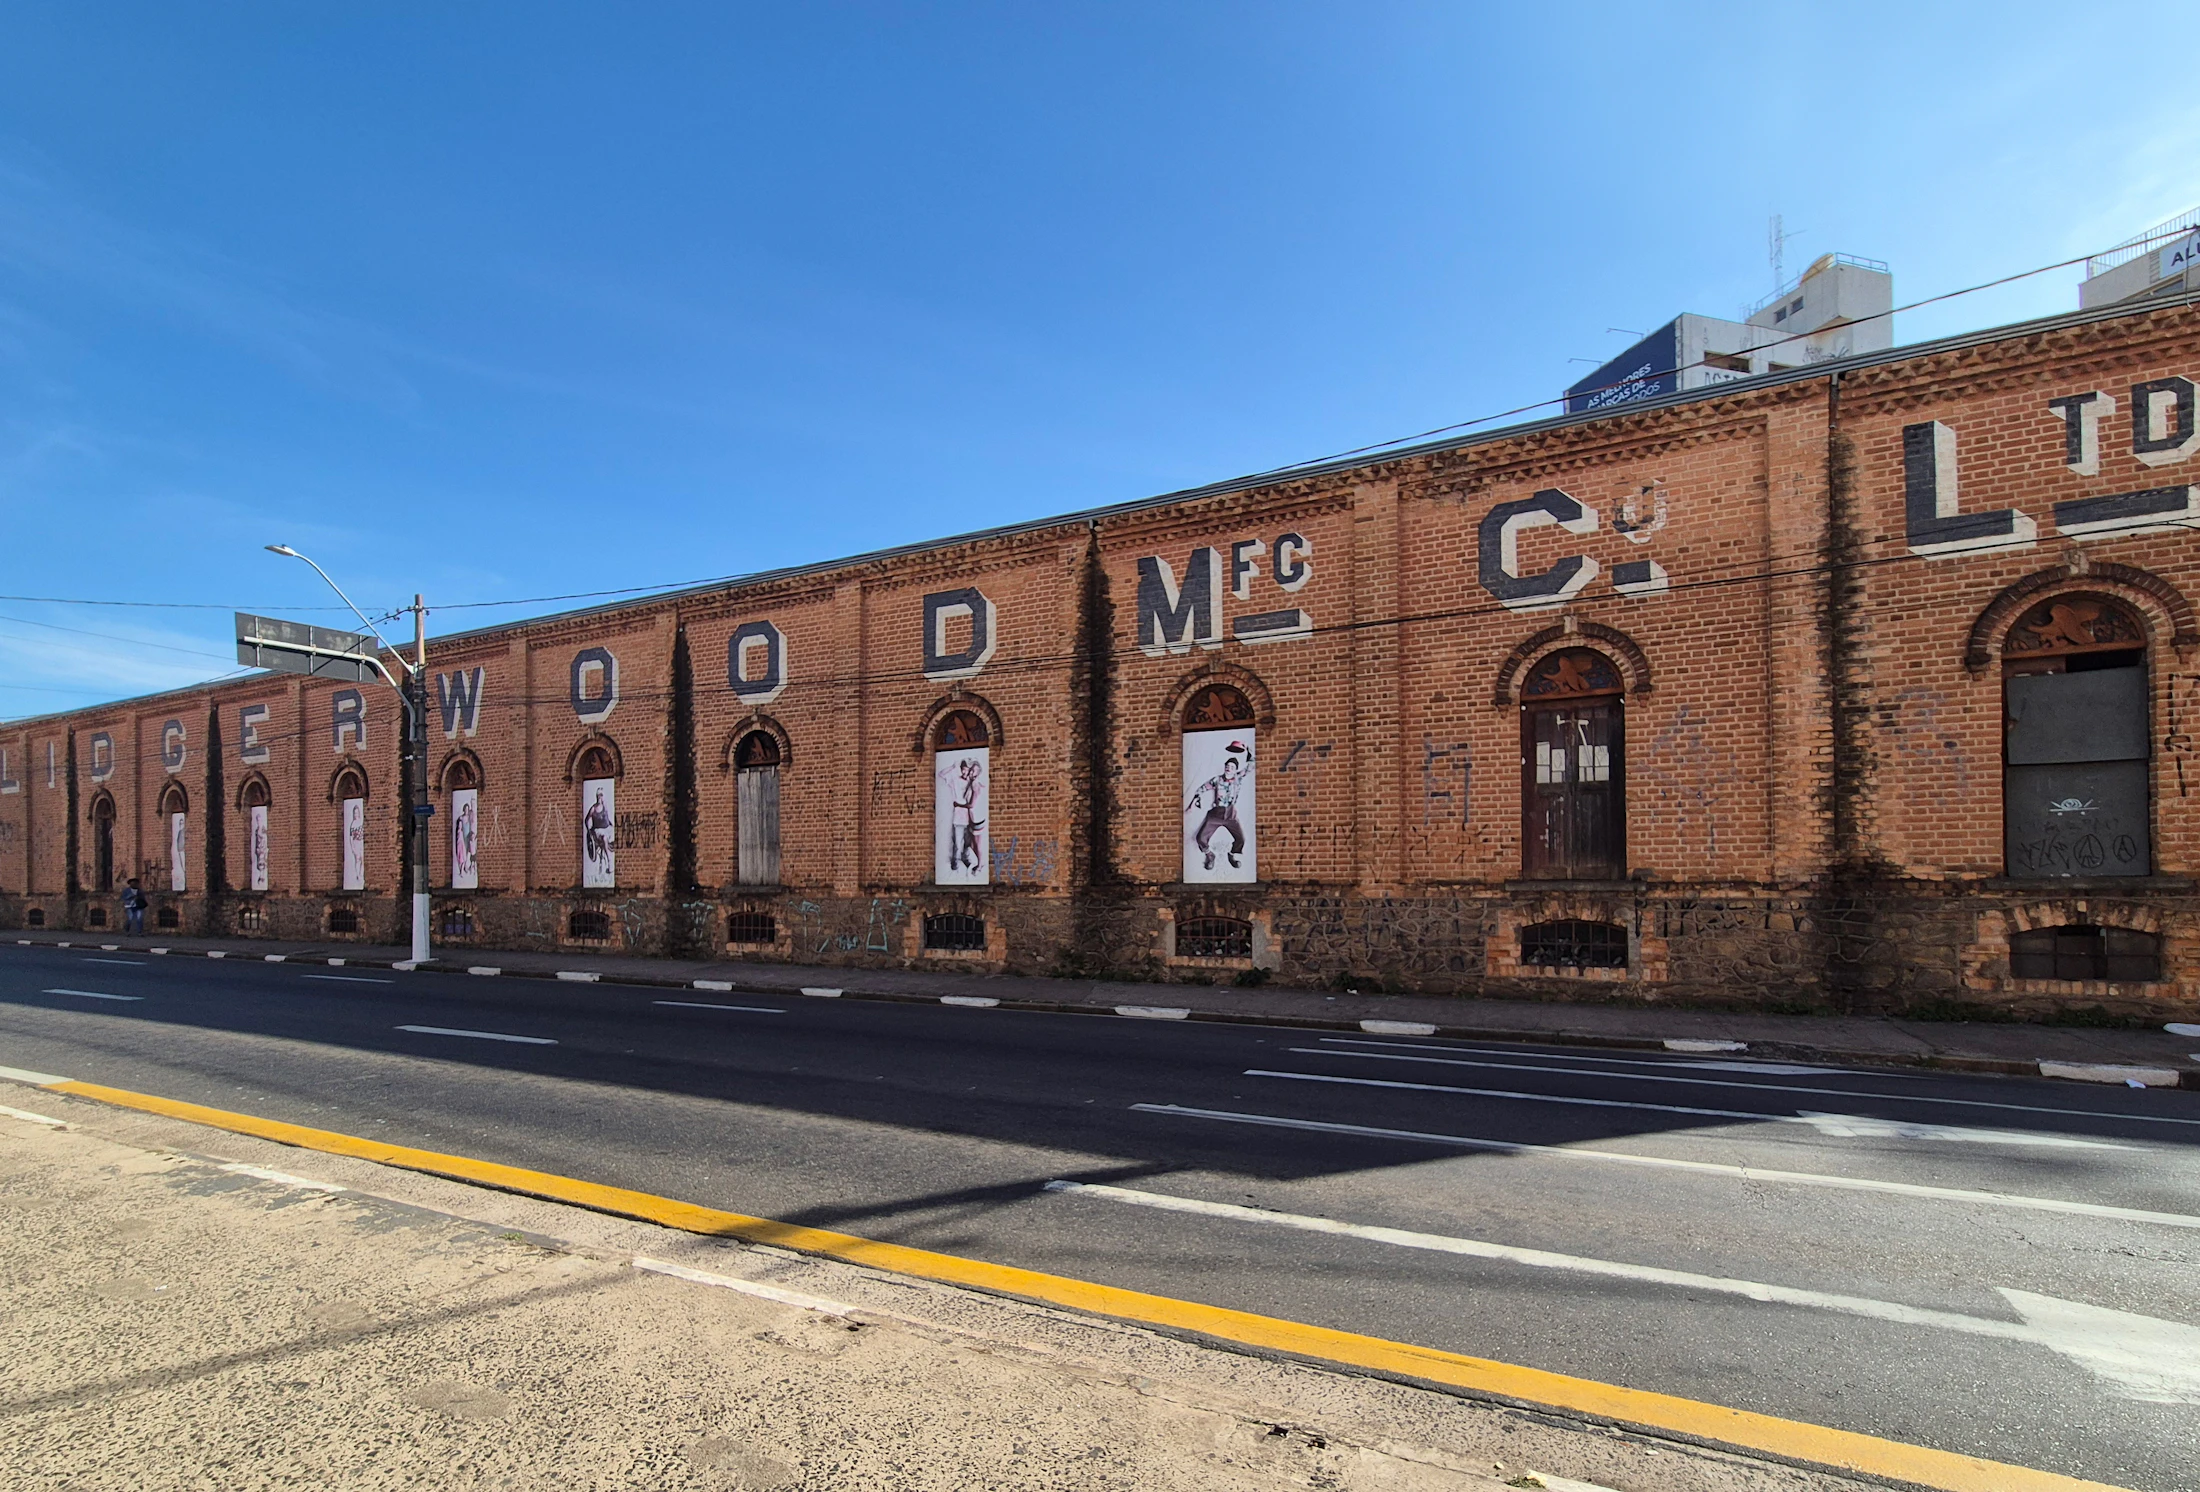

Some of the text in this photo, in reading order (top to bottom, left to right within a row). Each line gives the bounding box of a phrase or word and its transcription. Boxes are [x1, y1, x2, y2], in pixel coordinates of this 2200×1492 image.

[1587, 395, 1600, 409] AS
[1597, 379, 1646, 408] ARCAS DE
